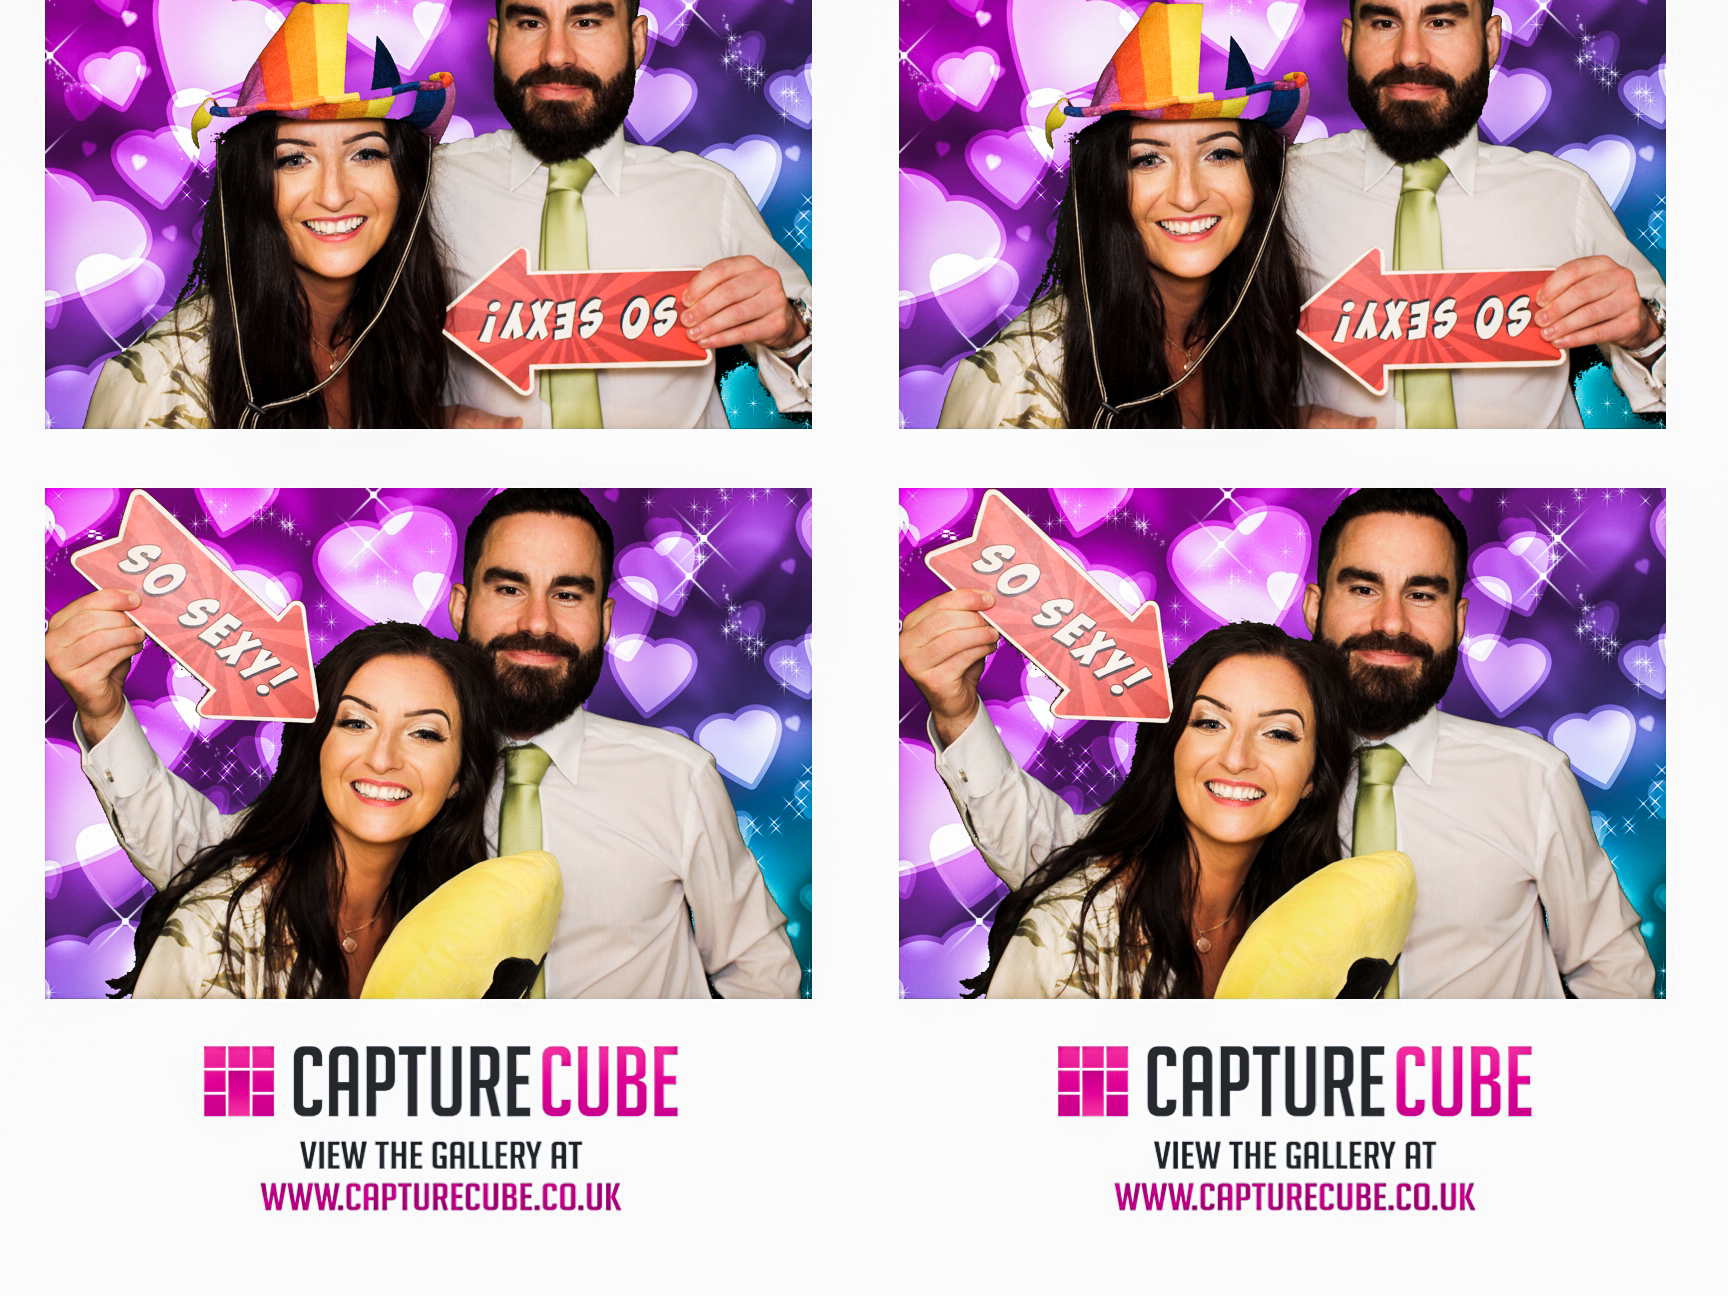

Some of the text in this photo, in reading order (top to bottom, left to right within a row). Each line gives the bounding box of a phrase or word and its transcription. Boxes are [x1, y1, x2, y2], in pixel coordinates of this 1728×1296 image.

[477, 294, 678, 344] SO SEXY!
[1331, 294, 1532, 344] SO SEXY!
[117, 544, 299, 697] SO SEXY!
[971, 544, 1153, 697] SO SEXY!
